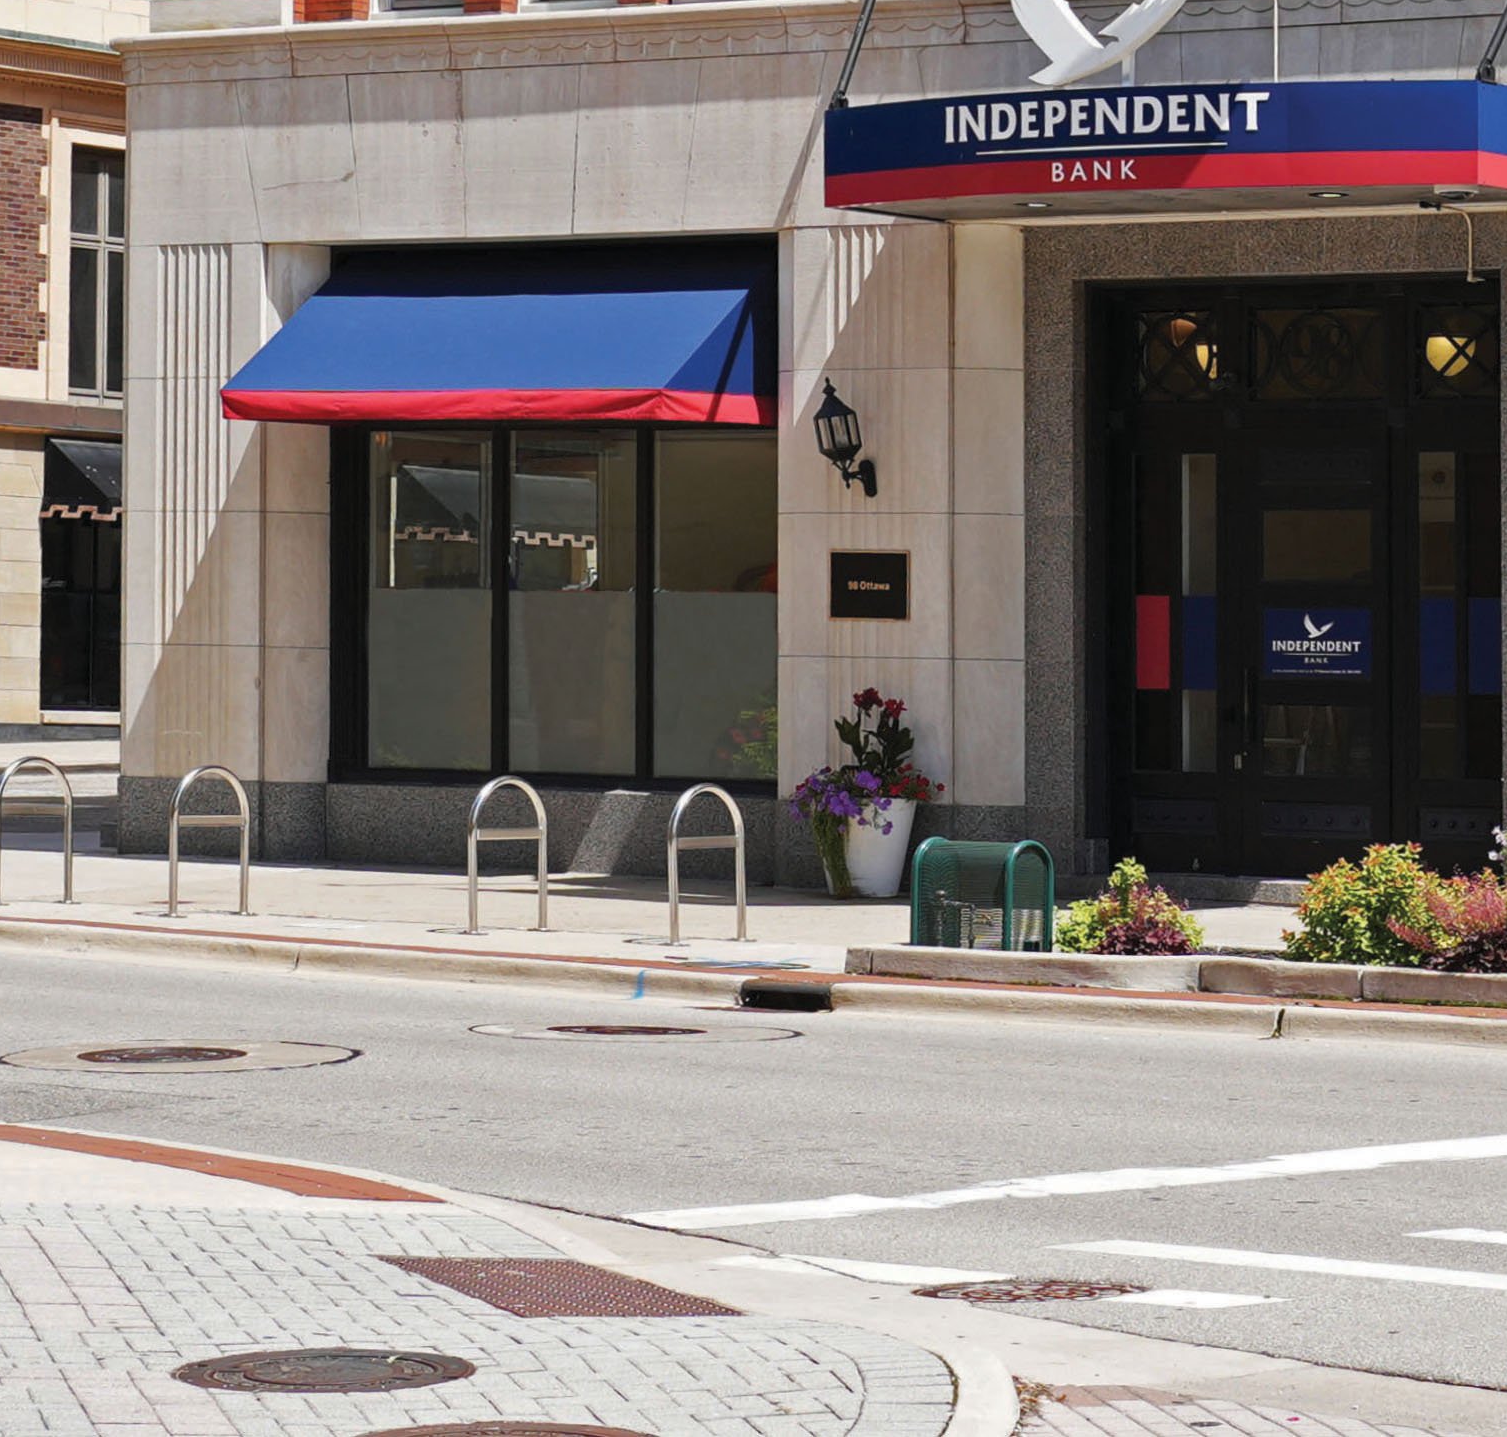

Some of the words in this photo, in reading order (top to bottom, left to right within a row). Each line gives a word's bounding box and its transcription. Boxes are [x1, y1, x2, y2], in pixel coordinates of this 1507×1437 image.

[944, 91, 1270, 144] INDEPENDENT
[1051, 159, 1138, 183] BANK
[1272, 640, 1362, 653] INDEPENDENT
